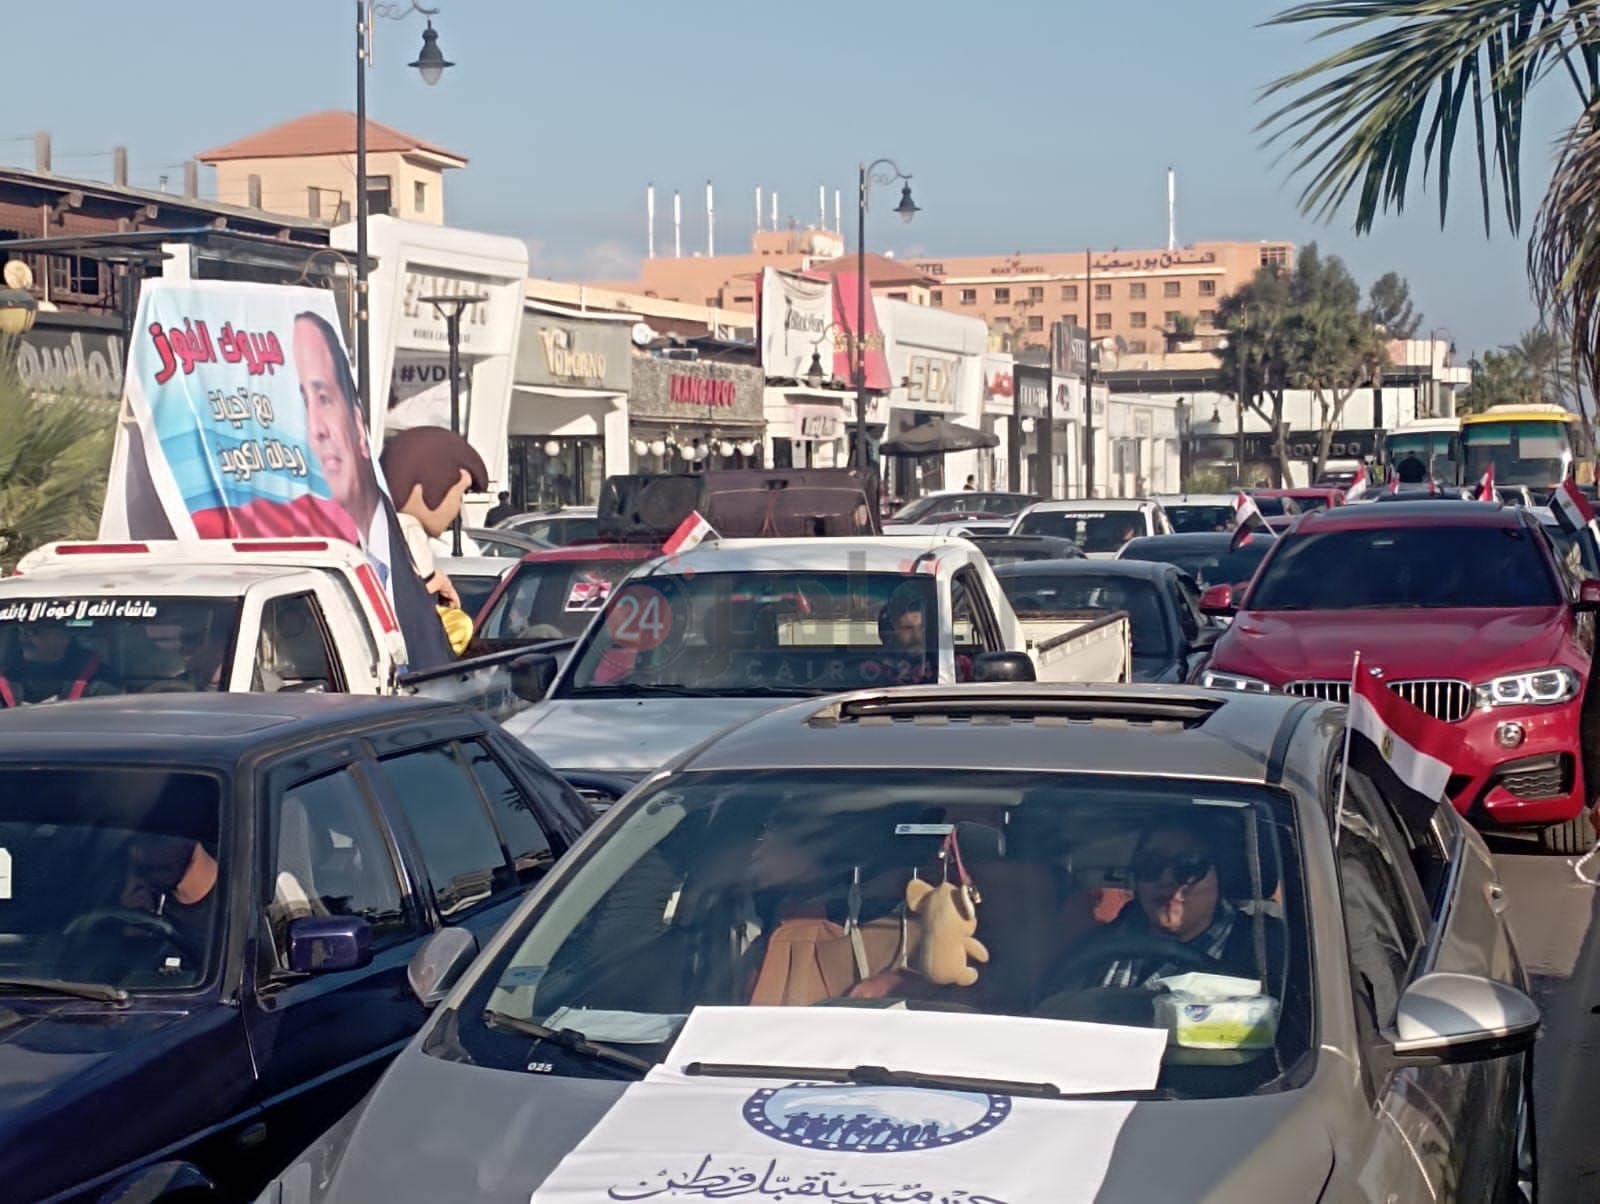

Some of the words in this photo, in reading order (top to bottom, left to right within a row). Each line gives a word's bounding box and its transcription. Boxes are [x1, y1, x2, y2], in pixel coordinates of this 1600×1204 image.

[148, 317, 217, 385] الفوز
[218, 321, 285, 376] مبروك
[208, 387, 251, 429] تحيات
[252, 392, 273, 429] مع
[263, 438, 308, 477] رجالة
[88, 600, 114, 617] الله
